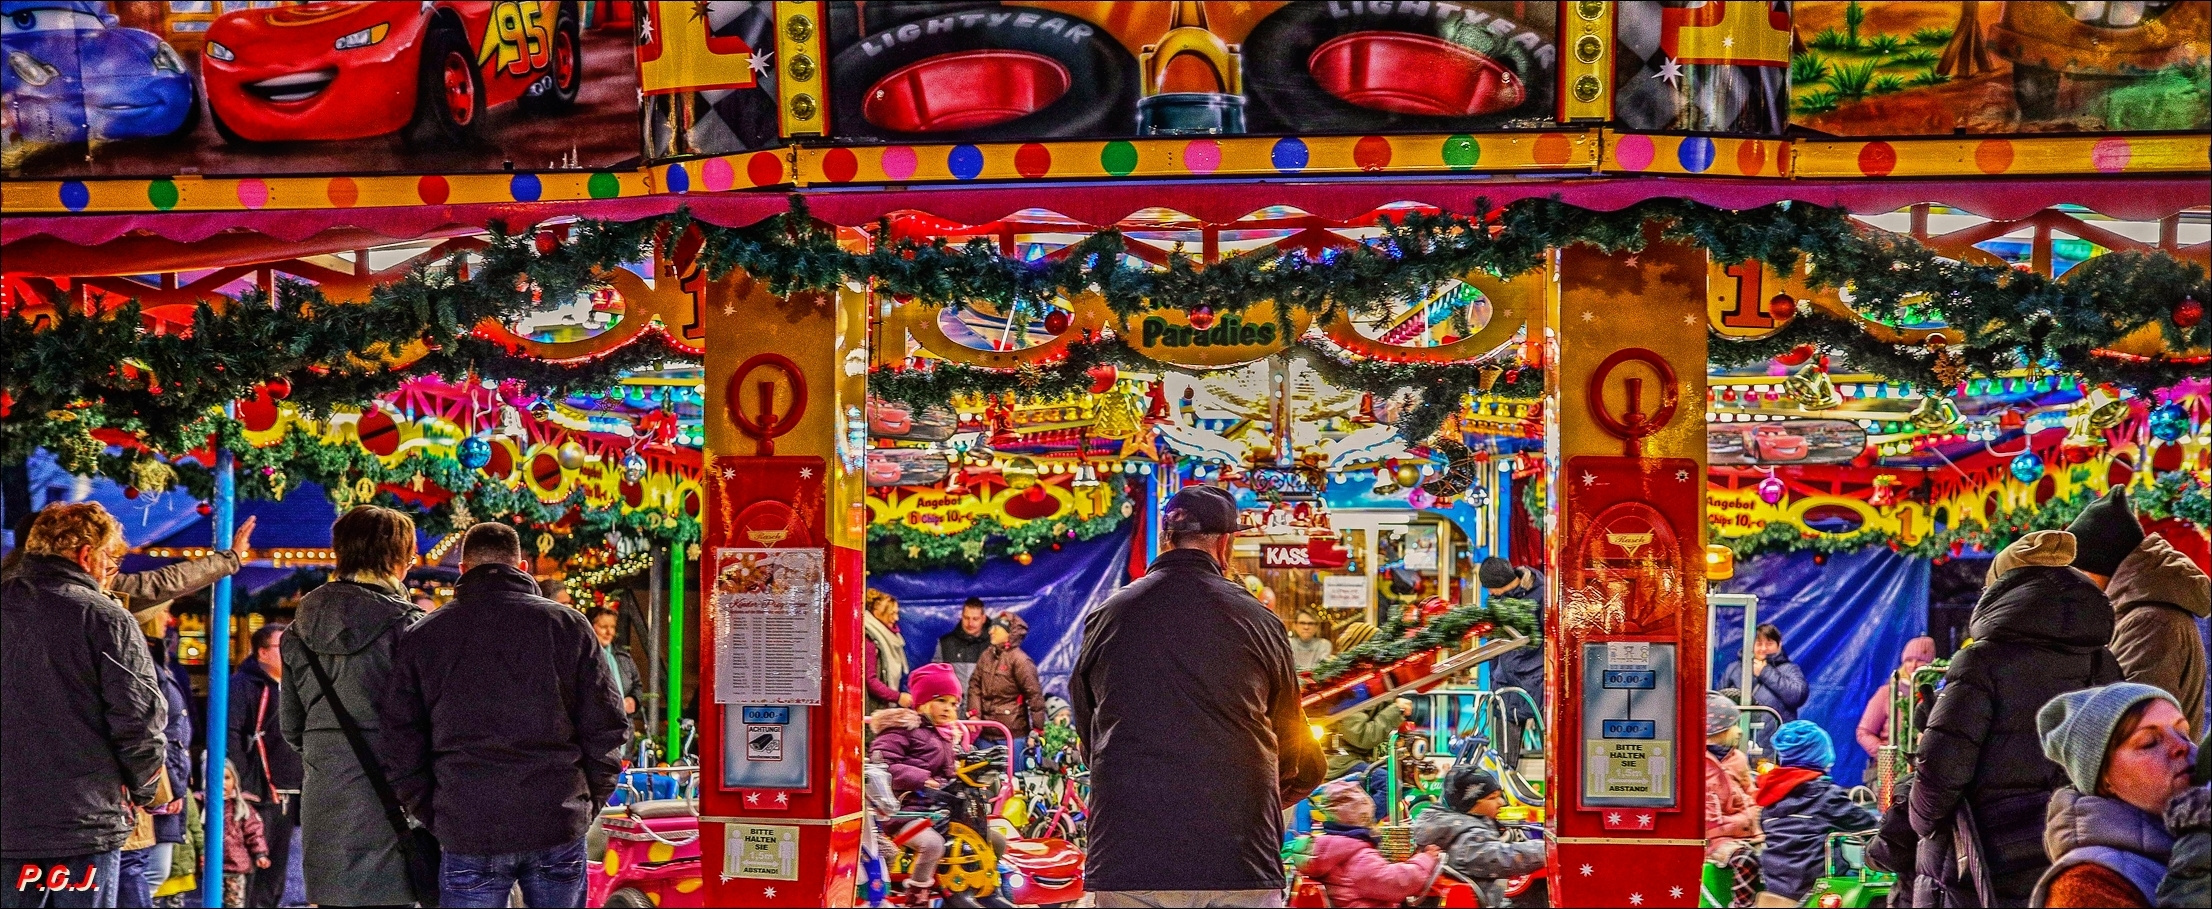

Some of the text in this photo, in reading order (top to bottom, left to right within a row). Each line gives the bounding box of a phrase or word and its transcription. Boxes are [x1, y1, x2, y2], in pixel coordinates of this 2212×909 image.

[495, 1, 550, 75] 95
[861, 12, 1094, 57] LIGHTYEAR
[1142, 313, 1276, 348] Paradies
[917, 495, 962, 509] Angebot
[1266, 547, 1311, 565] KASS
[750, 828, 774, 836] BITTE
